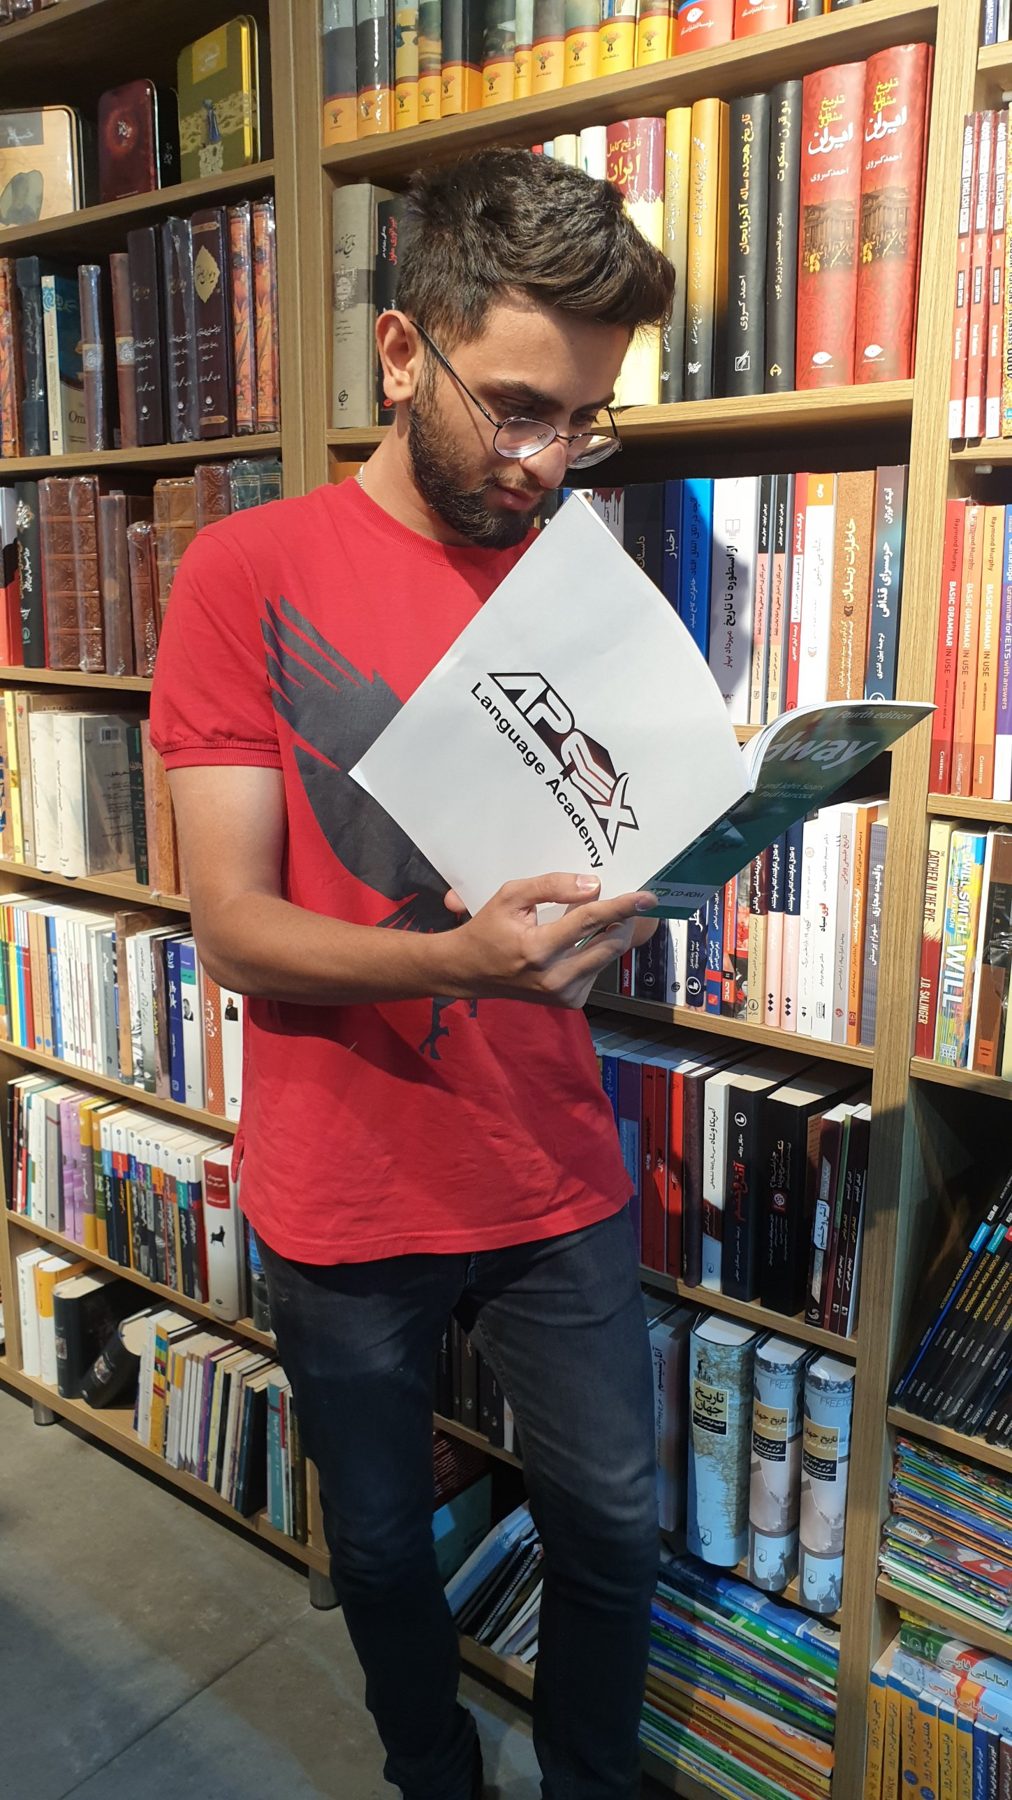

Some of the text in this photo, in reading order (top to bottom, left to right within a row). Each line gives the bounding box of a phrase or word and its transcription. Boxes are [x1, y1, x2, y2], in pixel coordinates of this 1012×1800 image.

[876, 77, 899, 95] تاریخ
[821, 94, 846, 111] تاریخ
[808, 122, 854, 155] ایران
[865, 105, 908, 142] ایران
[621, 133, 642, 152] تاریخ
[775, 100, 791, 182] دو قرن سکوت
[606, 153, 641, 185] ایران
[739, 113, 754, 255] تاریخ هجده ساله آذربایجان
[738, 275, 749, 331] احمد کسروی
[664, 529, 678, 559] اخبار
[842, 518, 859, 565] خاطرات
[949, 518, 960, 572] Raymond Murphy
[987, 516, 997, 571] Raymond Murphy
[967, 547, 976, 570] Murphy
[723, 545, 737, 627] از اسطوره تا تاریخ
[841, 567, 856, 604] زندان
[876, 542, 893, 618] حرمسرای قذافی
[1004, 585, 1012, 622] Grammar
[944, 581, 956, 674] BASIC GRAMMAR IN USE
[961, 583, 975, 675] BASIC GRAMMAR IN USE
[982, 584, 994, 677] BASIC GRAMMAR IN USE
[723, 630, 733, 668] مهرداد بهار
[1003, 635, 1012, 659] IELTS
[1003, 660, 1011, 677] with
[1001, 678, 1009, 710] answers
[835, 709, 914, 720] Fourth edition
[471, 682, 604, 869] Language Academy
[487, 672, 640, 856] APEX
[772, 849, 780, 861] طلاق
[788, 851, 796, 864] طلاق
[926, 849, 940, 881] CATCHER
[771, 878, 779, 890] کتاب
[871, 864, 884, 917] واقعیت مجازی
[925, 892, 936, 906] THE
[926, 883, 936, 891] IN
[957, 858, 971, 935] WILL SMITH
[752, 897, 760, 914] دانش
[819, 903, 829, 932] قوی سیاه
[923, 908, 935, 923] RYE
[948, 899, 956, 929] MANSON
[868, 924, 878, 966] شهرام پرستش
[941, 944, 967, 1008] WILL
[917, 976, 931, 1025] J.D. SALINGER
[707, 1106, 718, 1127] آمریکا
[708, 1133, 716, 1145] شاه
[817, 1203, 827, 1221] آتش
[694, 1400, 724, 1418] جهان
[695, 1386, 724, 1405] تاریخ
[770, 1416, 787, 1426] تاریخ
[820, 1435, 838, 1445] تاریخ
[897, 1523, 930, 1541] Ladybird
[940, 1655, 1009, 1688] ایتالیایی فارسی
[927, 1681, 958, 1699] فارسی
[923, 1721, 932, 1749] هلندی
[943, 1733, 951, 1757] فرانسه
